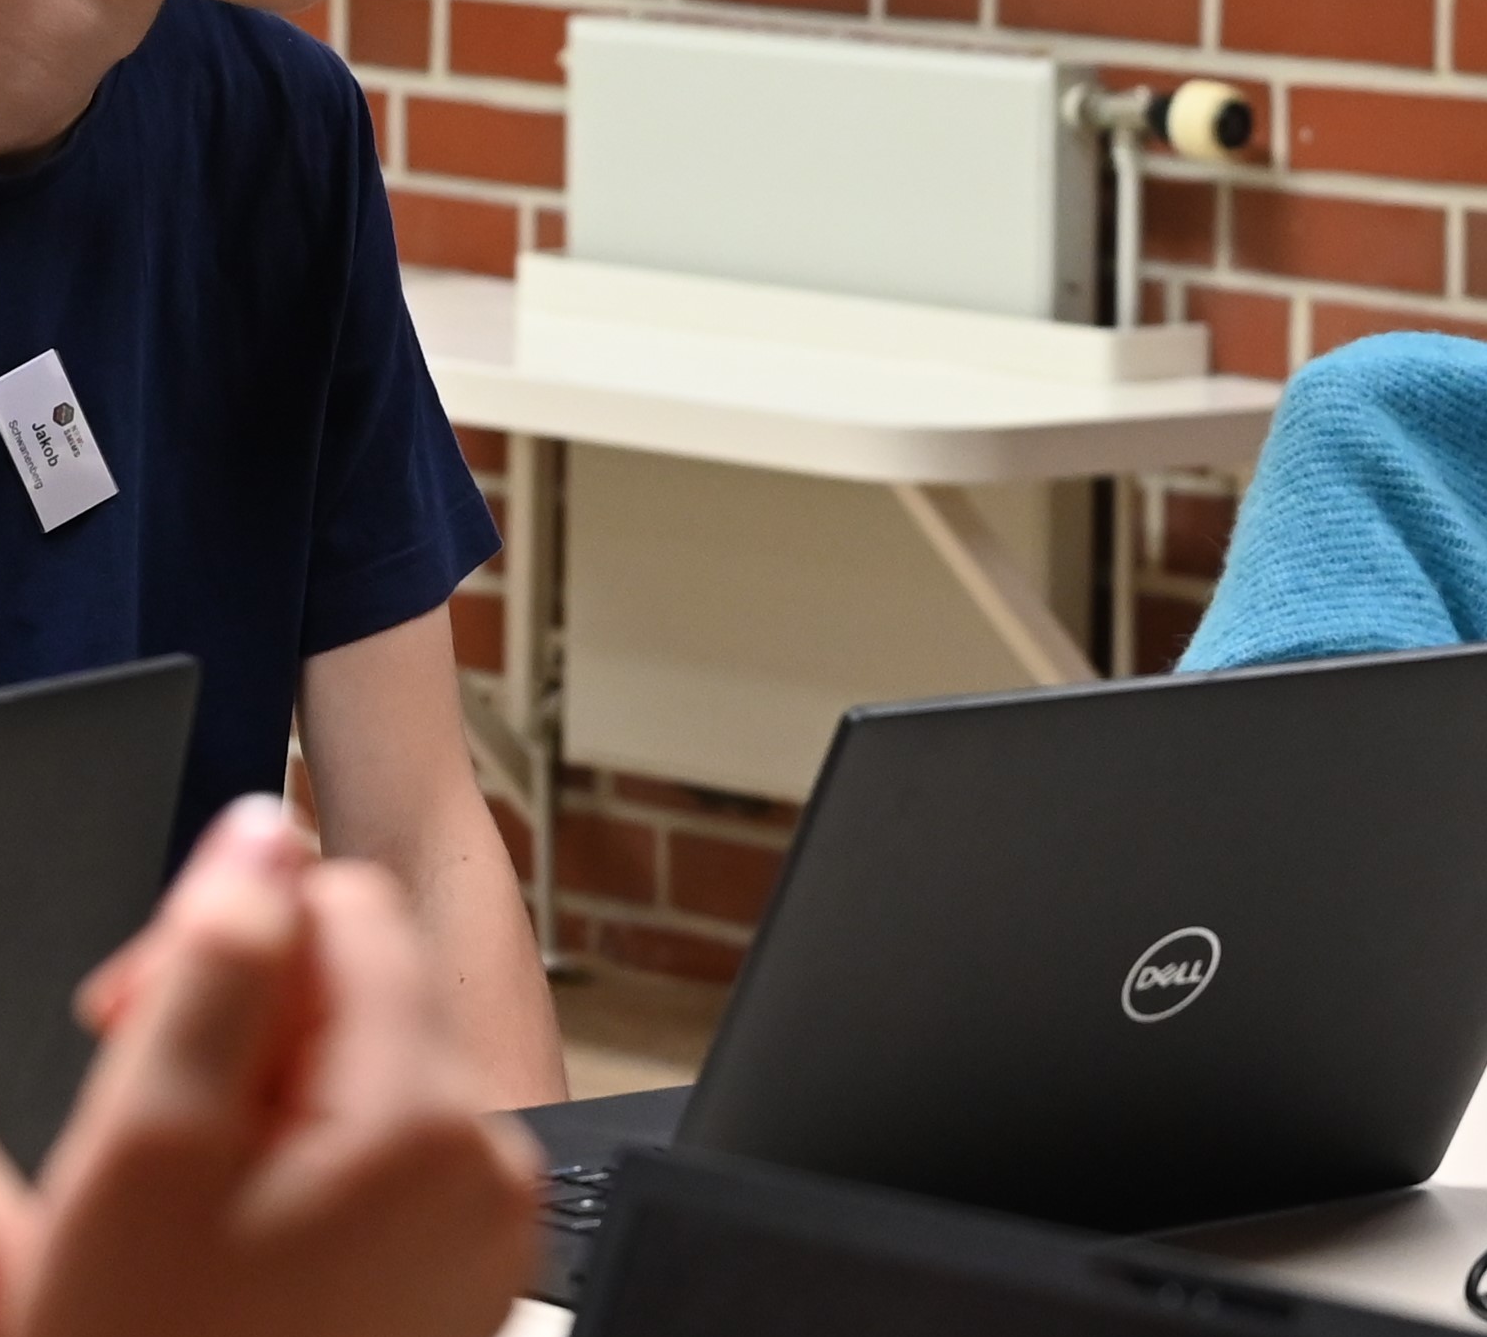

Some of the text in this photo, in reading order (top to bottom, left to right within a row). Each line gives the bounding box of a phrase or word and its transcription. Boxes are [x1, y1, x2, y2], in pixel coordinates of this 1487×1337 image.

[9, 420, 43, 490] Schwanenberg
[32, 422, 58, 467] Jakob
[1135, 959, 1203, 991] DELL
